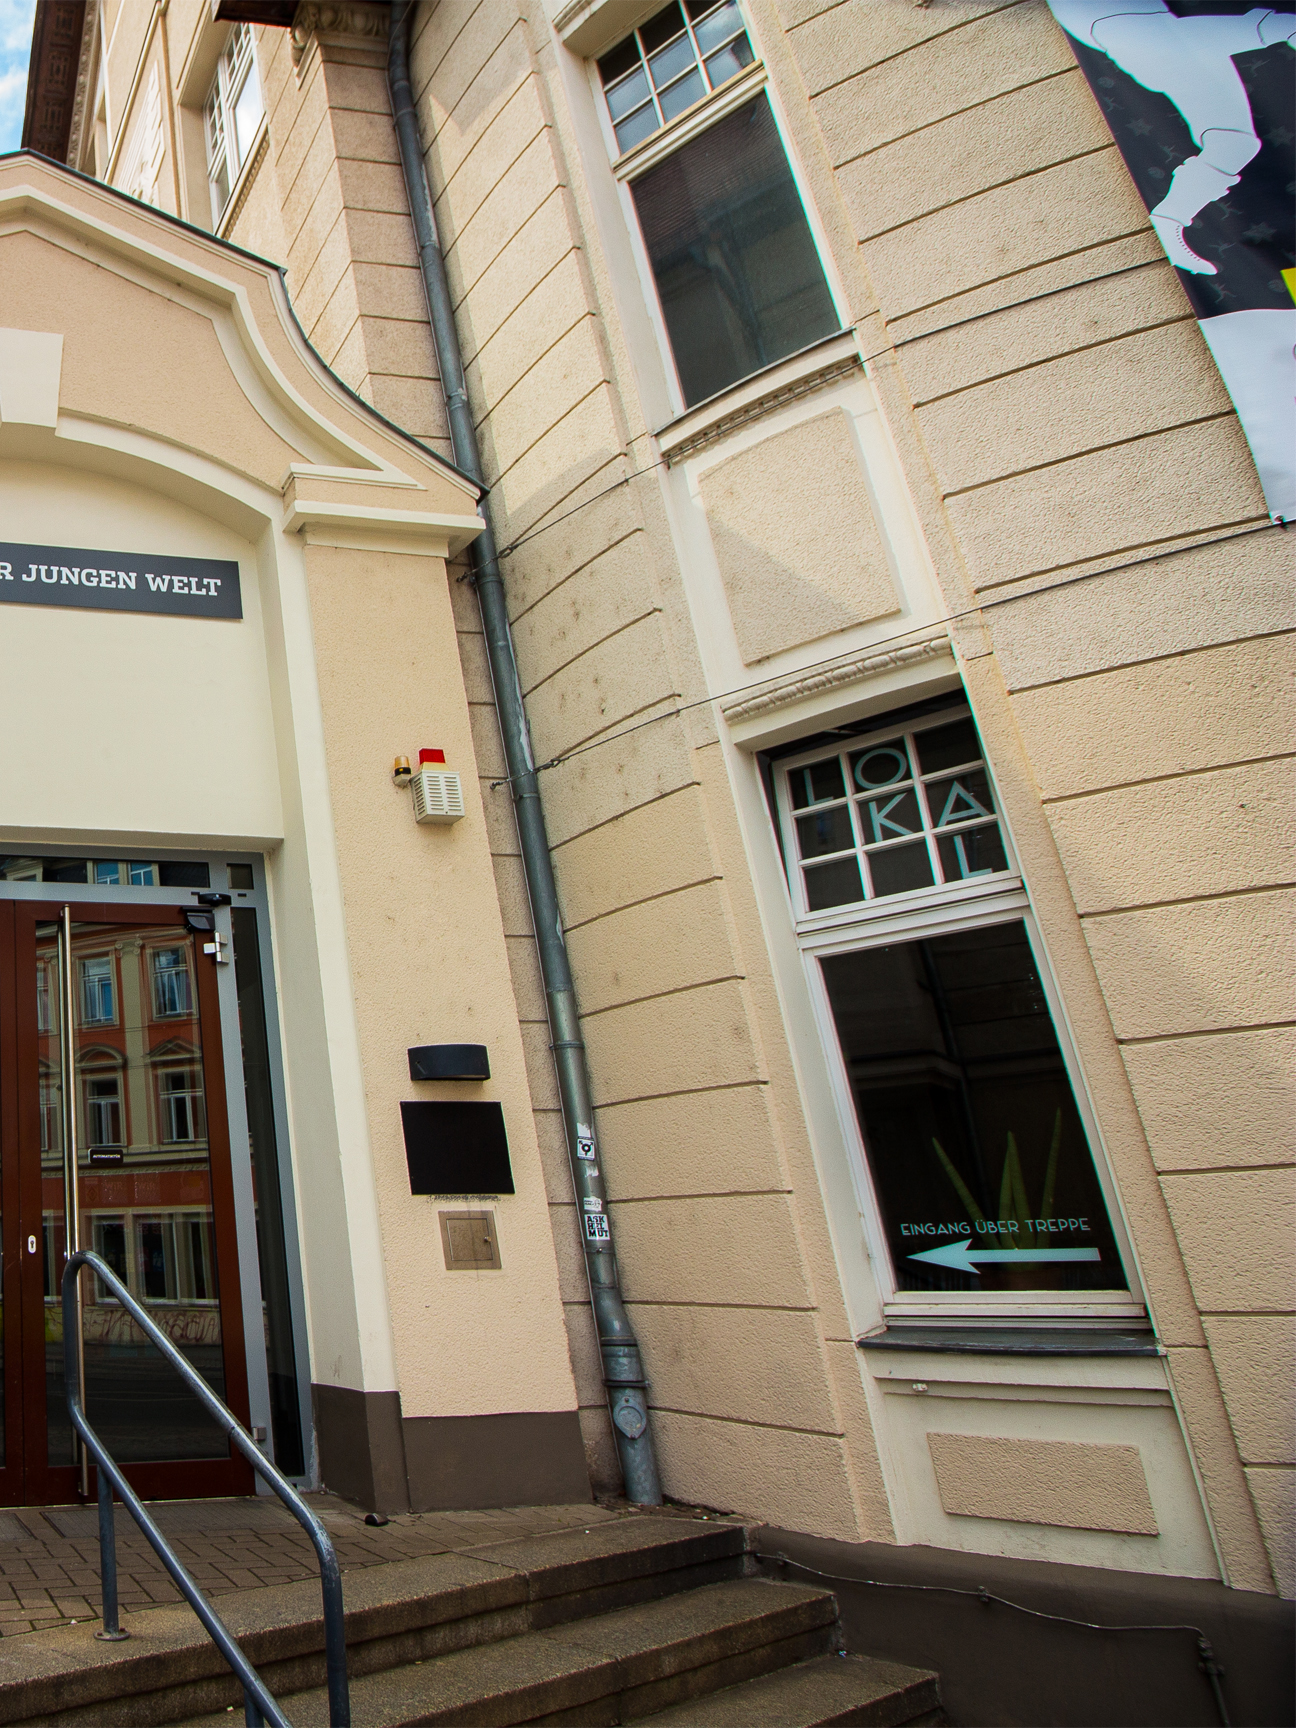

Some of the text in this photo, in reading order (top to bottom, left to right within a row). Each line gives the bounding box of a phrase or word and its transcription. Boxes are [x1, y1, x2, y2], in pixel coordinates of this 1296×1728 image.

[22, 563, 138, 590] JUNGEN
[145, 573, 221, 597] WELT
[586, 1215, 605, 1223] ASK
[588, 1229, 609, 1238] MUT
[900, 1217, 1091, 1236] EINGANG ÜBER TREPPE
